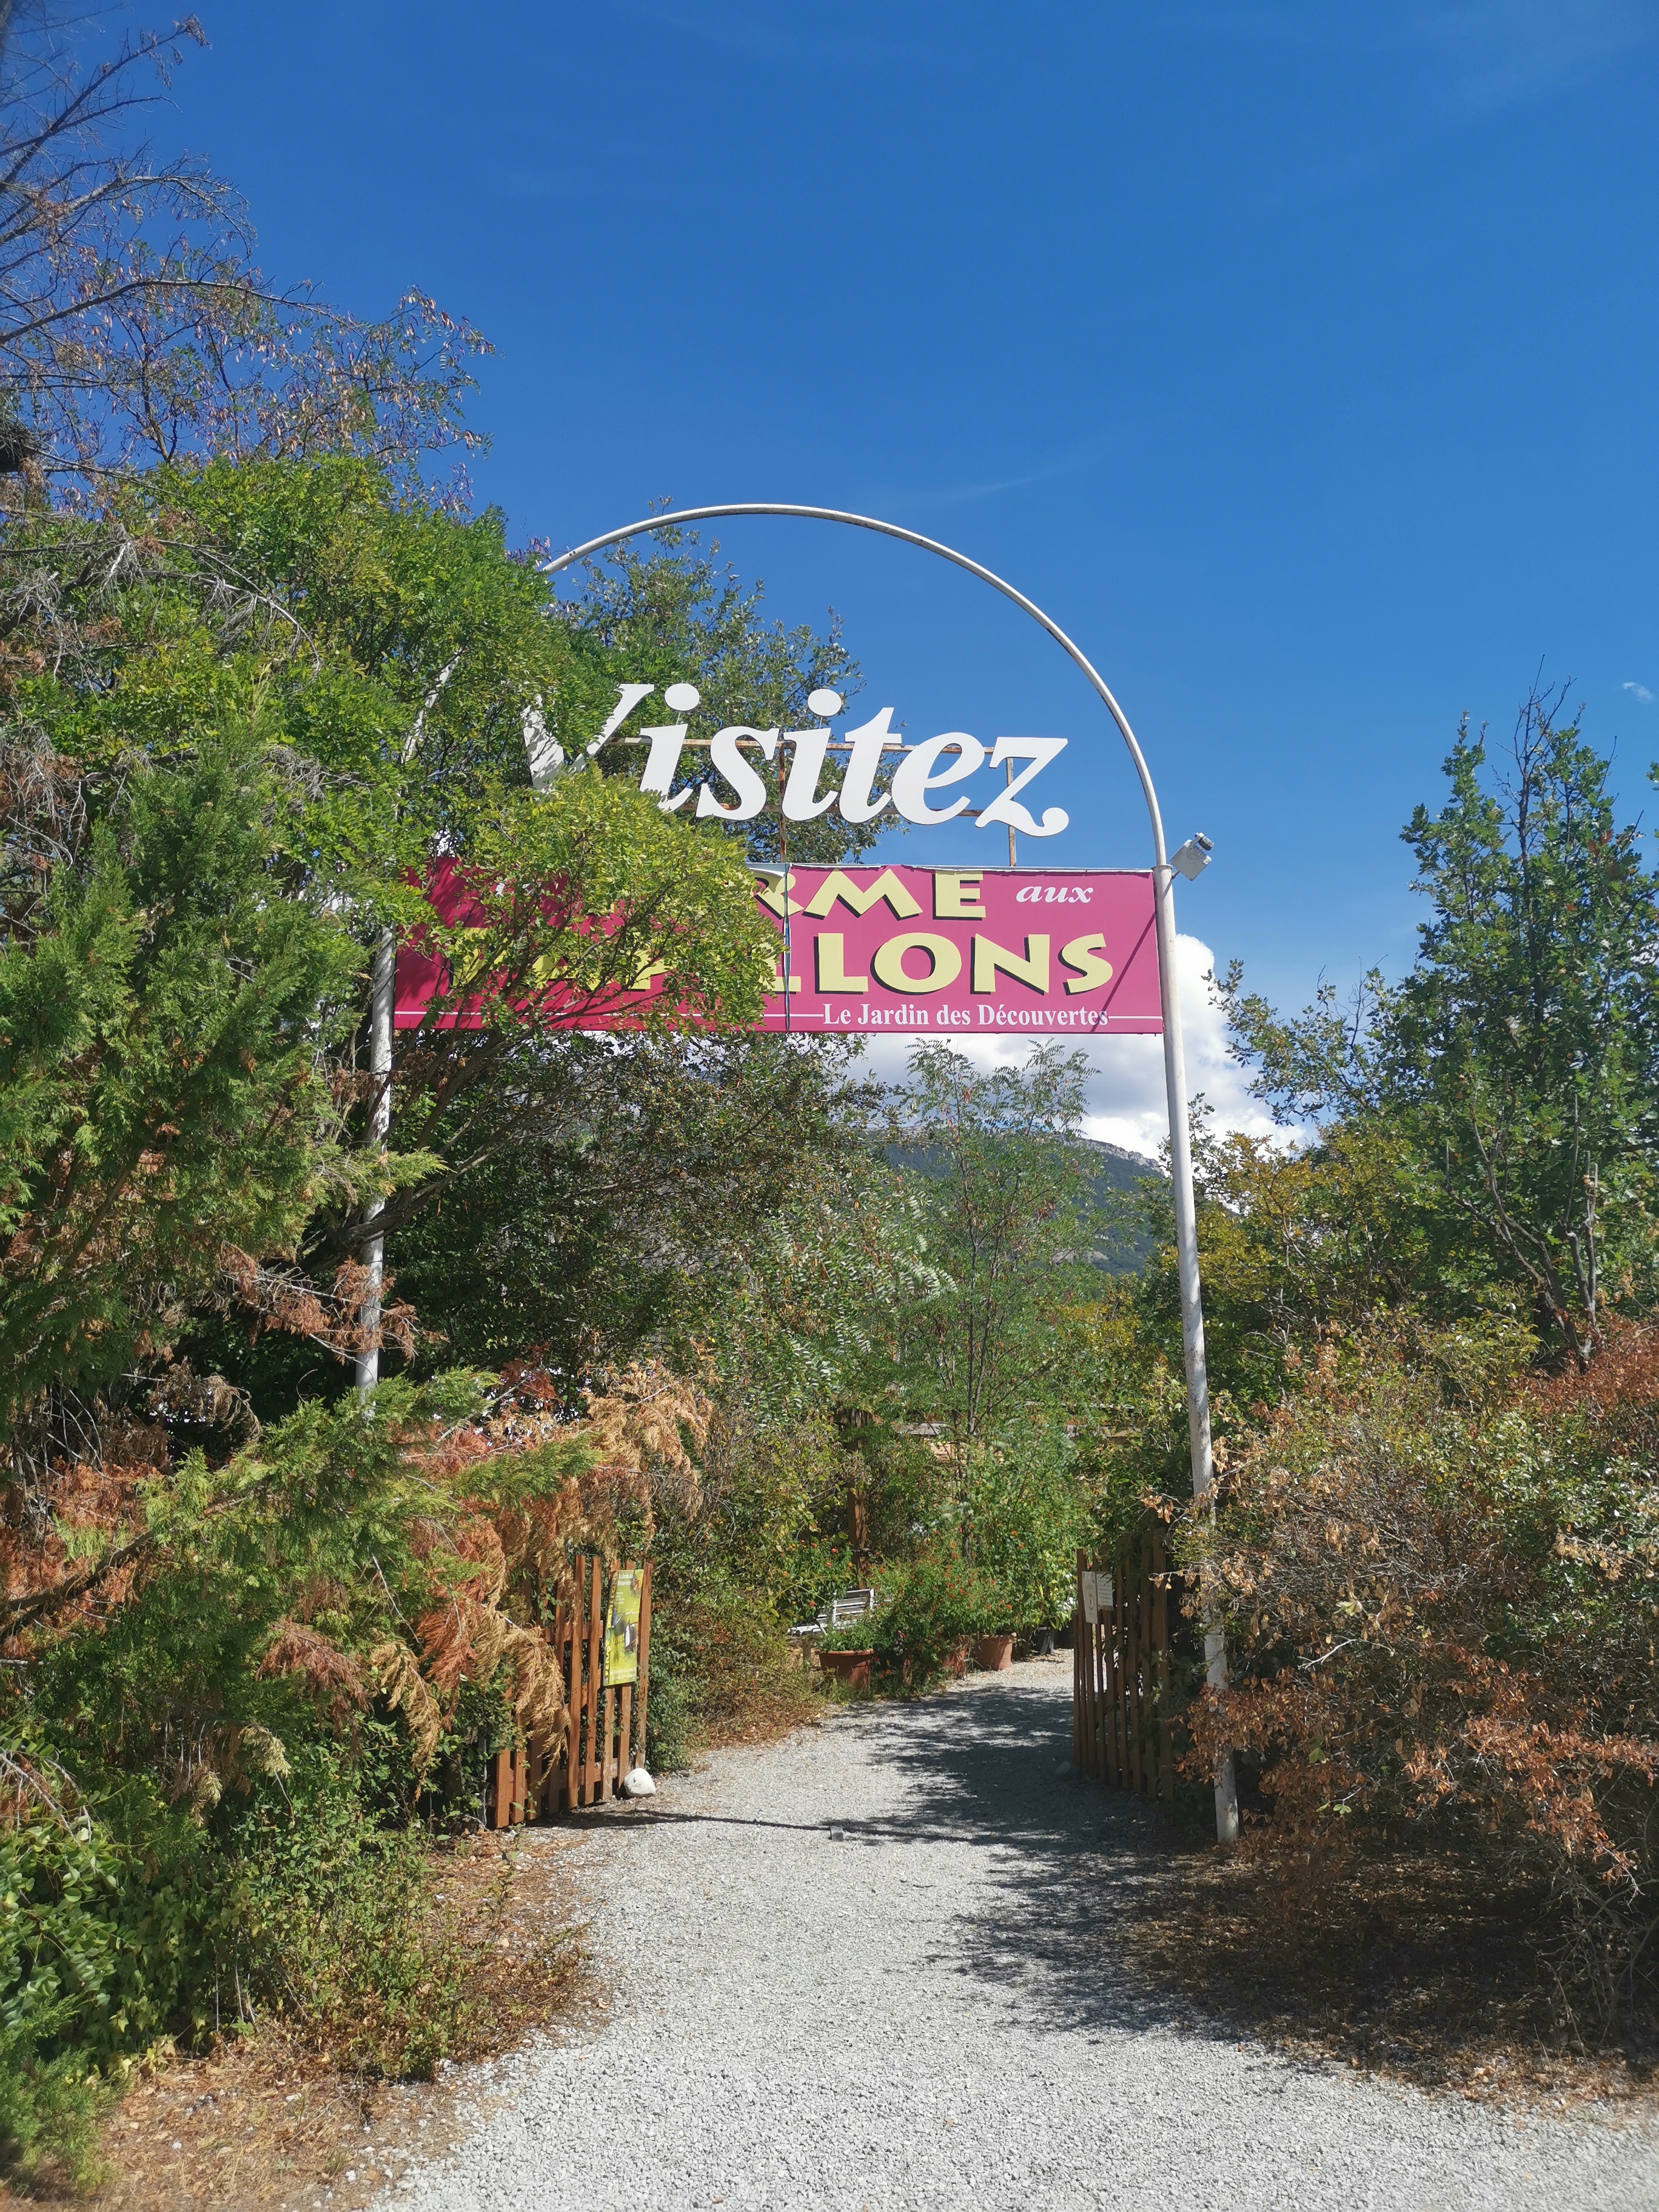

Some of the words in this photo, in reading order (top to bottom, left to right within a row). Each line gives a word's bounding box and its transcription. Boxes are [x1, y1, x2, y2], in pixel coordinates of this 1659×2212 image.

[521, 683, 1069, 837] Visitez
[1016, 883, 1094, 903] aux
[823, 1004, 851, 1025] Le
[857, 1004, 930, 1025] Jardin
[936, 1004, 971, 1025] des
[977, 1004, 1108, 1026] Découvertes
